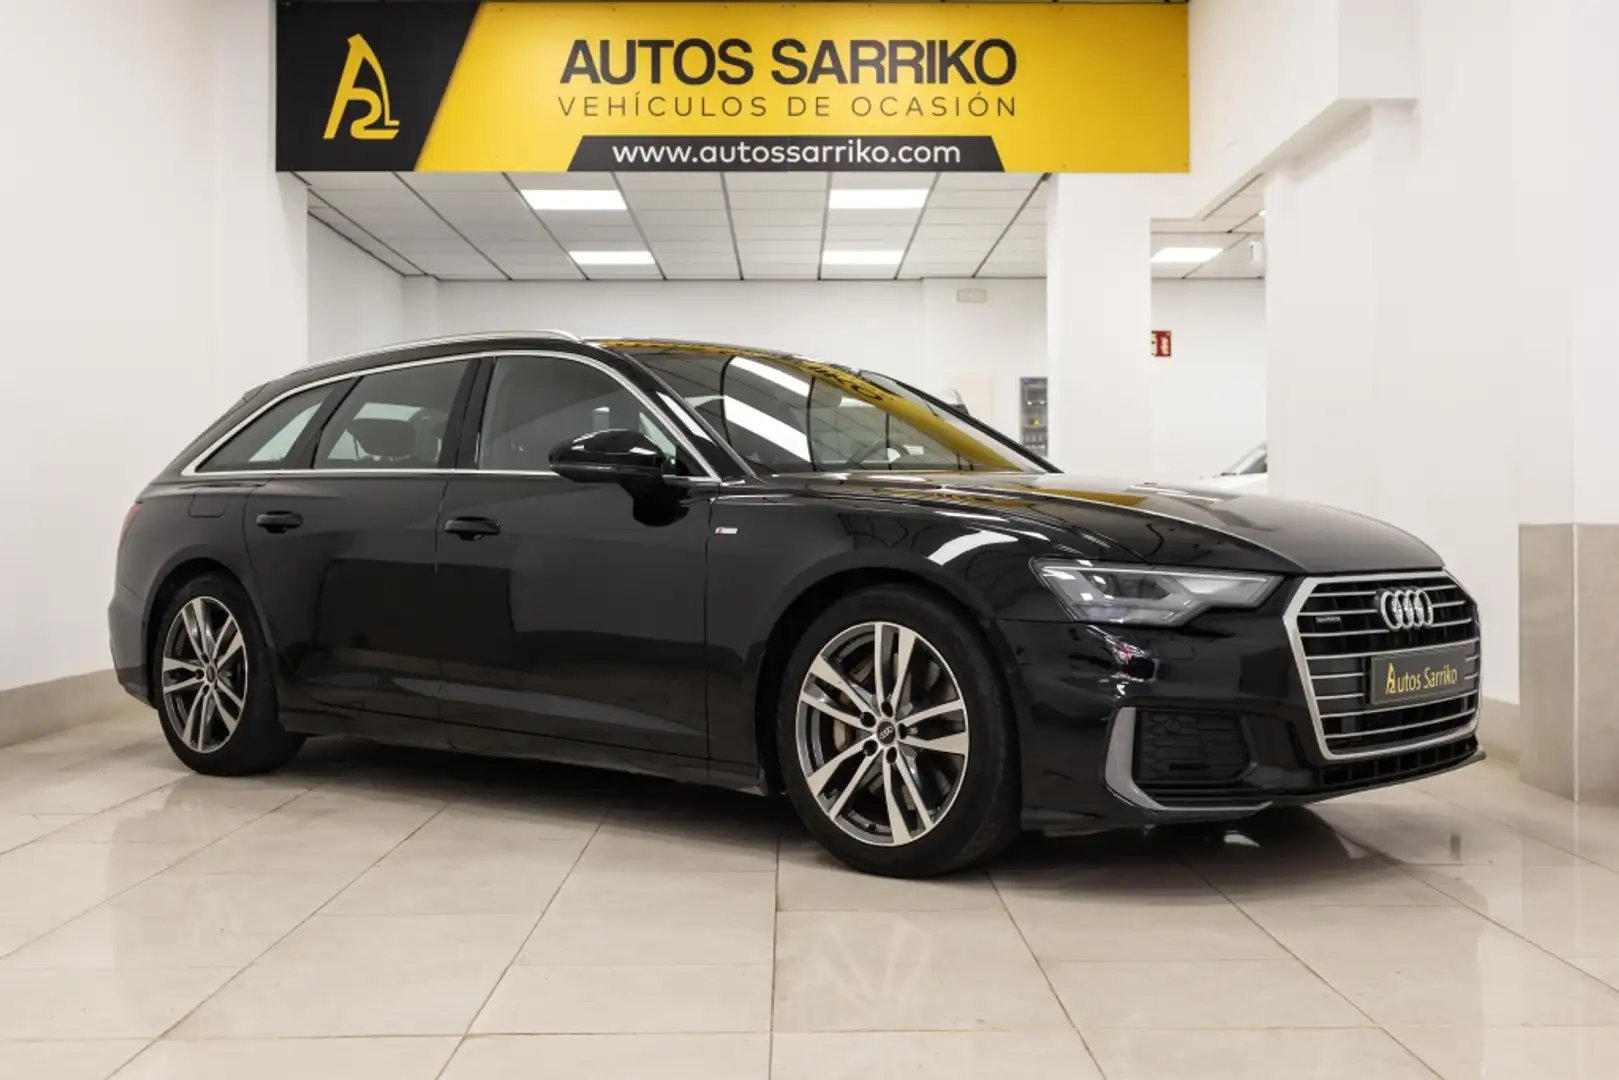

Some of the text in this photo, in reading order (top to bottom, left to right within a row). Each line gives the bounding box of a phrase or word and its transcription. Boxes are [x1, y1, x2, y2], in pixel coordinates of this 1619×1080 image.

[559, 38, 1017, 86] AUTOS SARRIKO
[558, 91, 1015, 117] VEHÍCULOS DE OCASIÓN
[612, 137, 961, 164] www.autossarriko.com
[1385, 662, 1458, 695] Autos Sarriko
